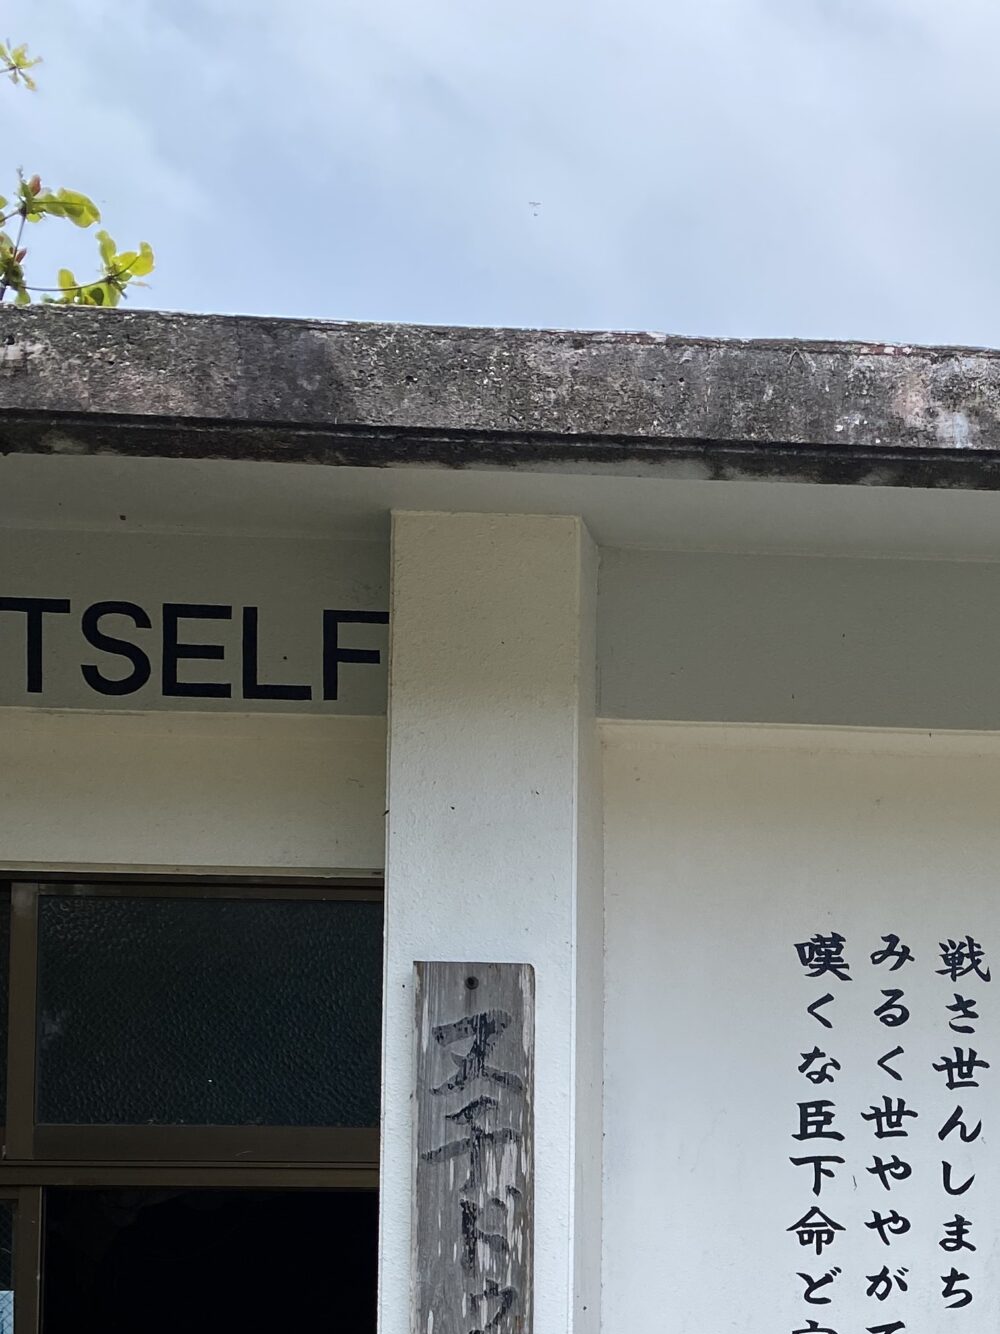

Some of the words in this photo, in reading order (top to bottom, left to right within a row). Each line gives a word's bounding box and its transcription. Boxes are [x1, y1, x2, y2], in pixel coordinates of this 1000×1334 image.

[932, 936, 991, 1308] 戦さ世んしまち
